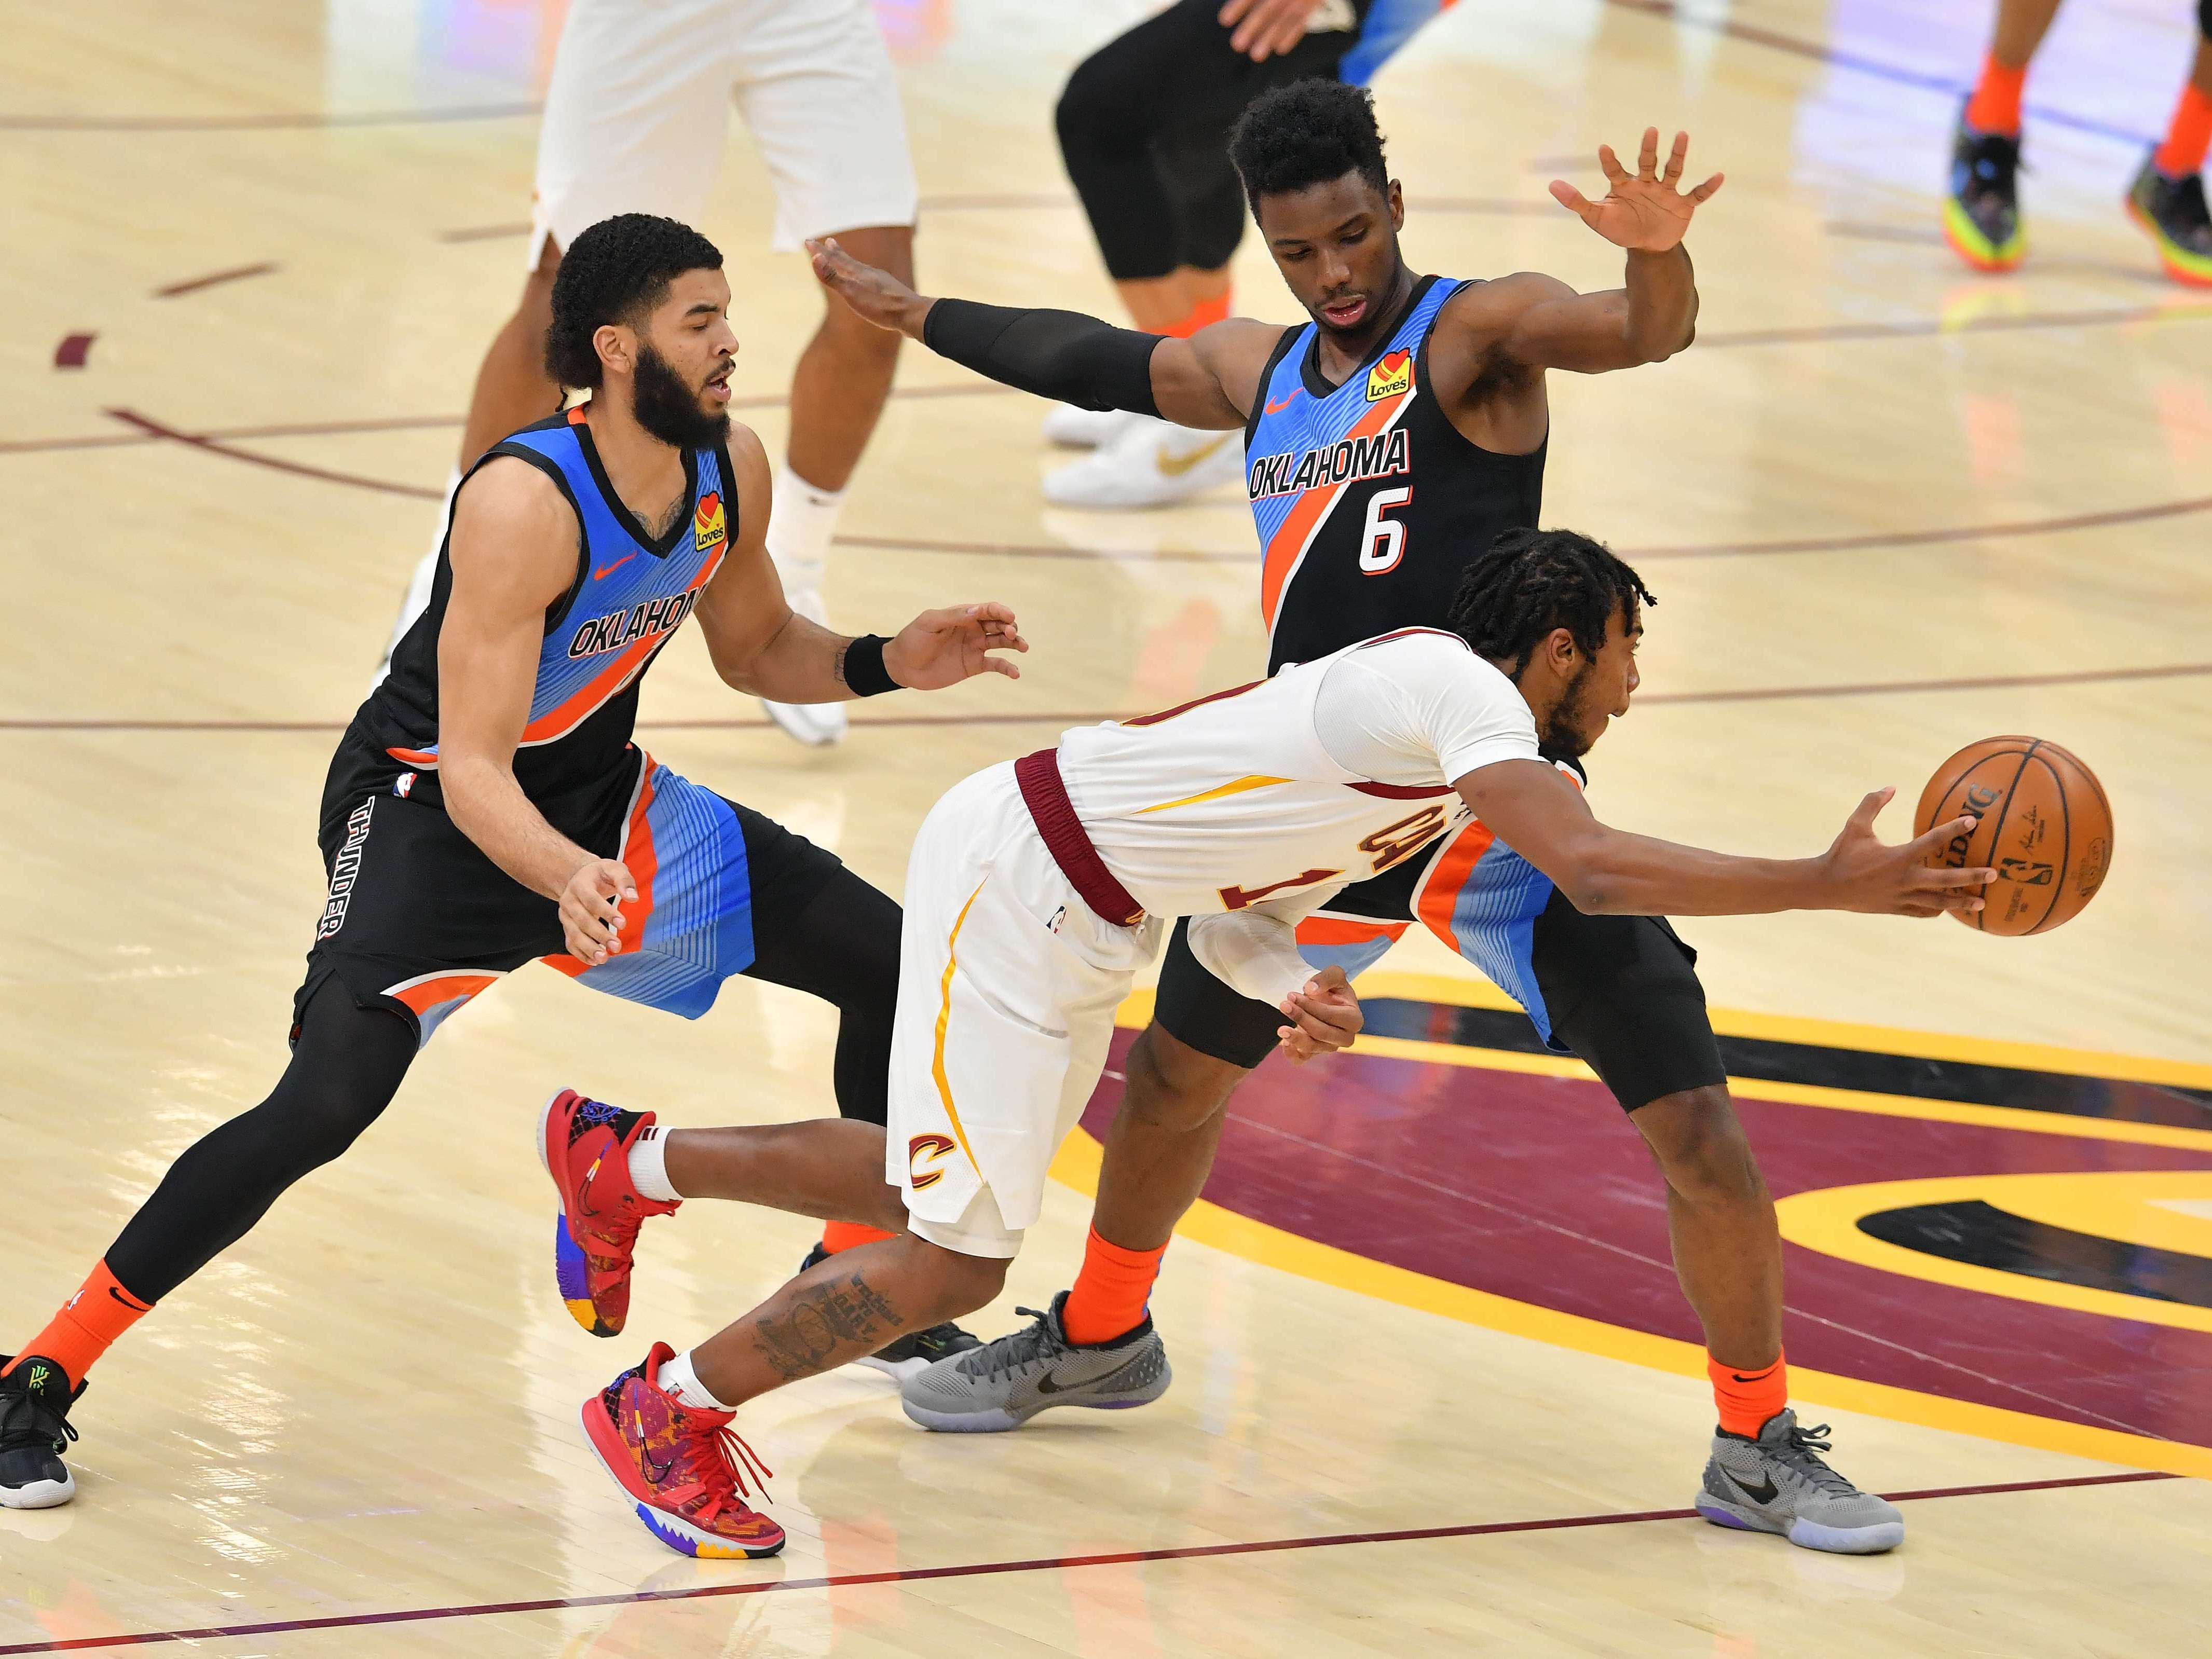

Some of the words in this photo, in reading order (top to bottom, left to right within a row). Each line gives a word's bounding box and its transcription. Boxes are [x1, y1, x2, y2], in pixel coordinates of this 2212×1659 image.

[1248, 429, 1410, 502] OKLAHOMA
[1359, 485, 1413, 576] 6
[317, 796, 375, 941] THUNDER
[1217, 867, 1346, 912] 1
[909, 1132, 958, 1192] C
